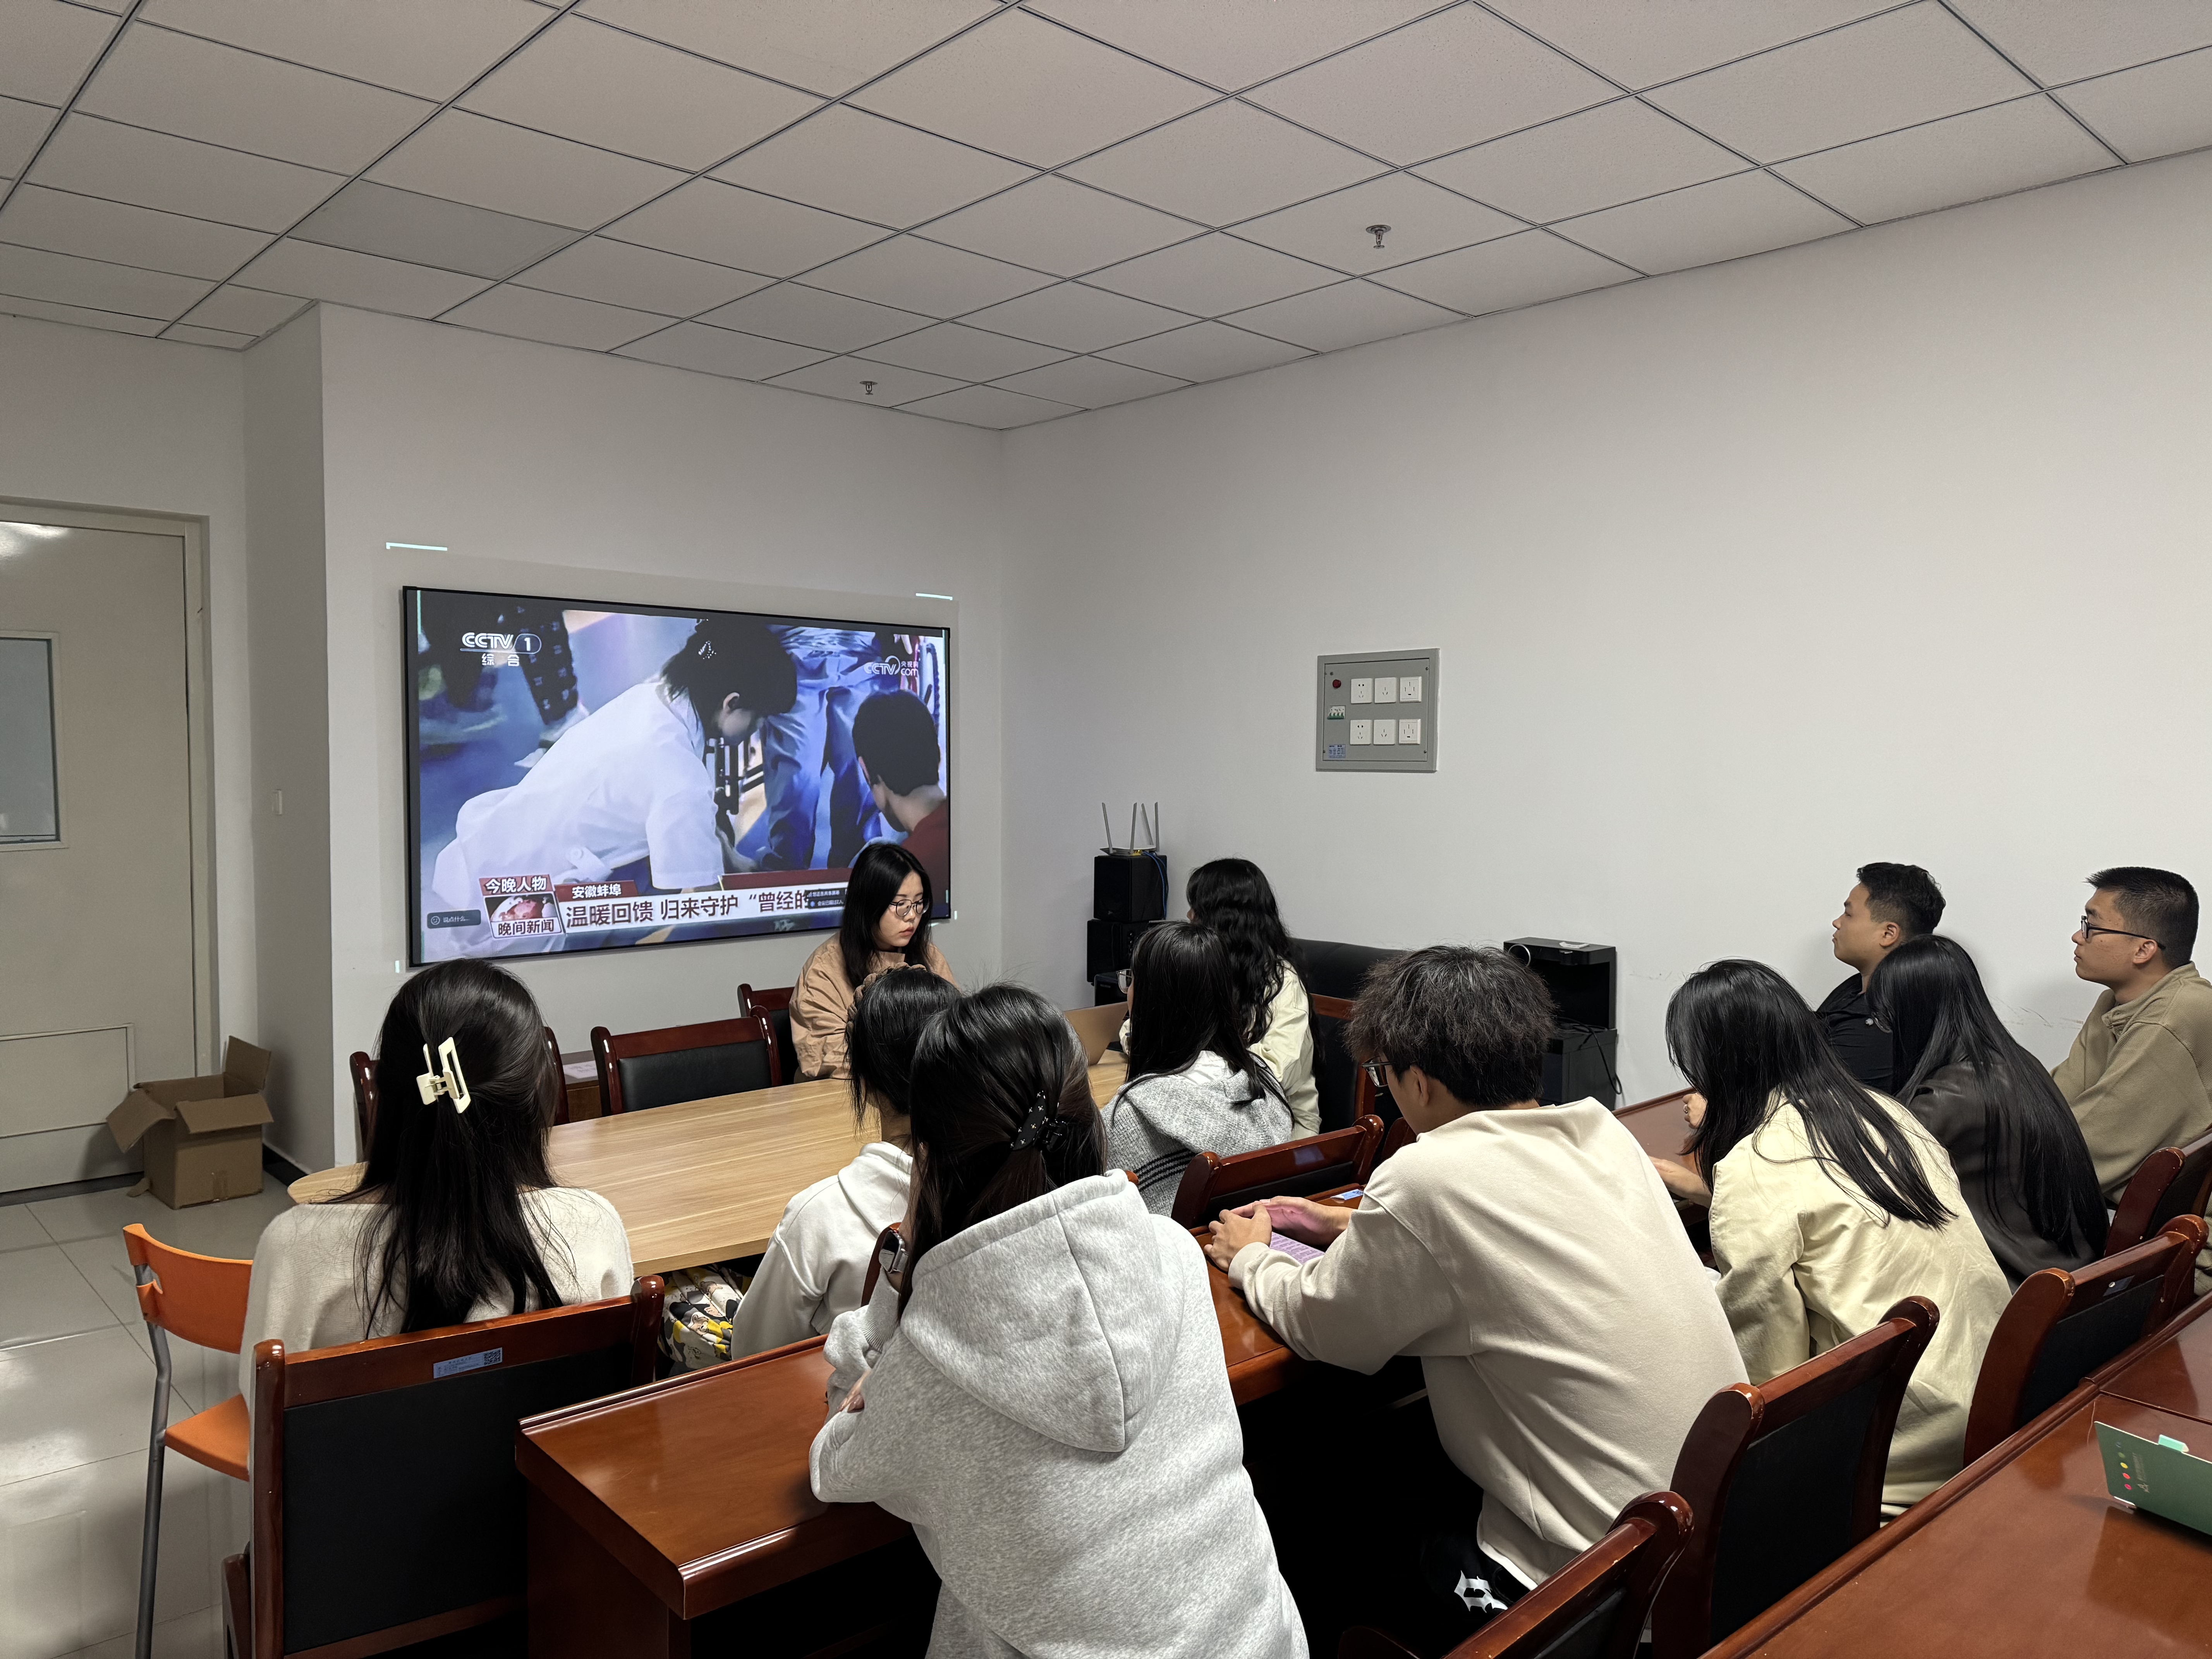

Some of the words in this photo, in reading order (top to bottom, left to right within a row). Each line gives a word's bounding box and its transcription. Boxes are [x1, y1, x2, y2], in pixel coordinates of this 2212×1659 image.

[462, 632, 514, 649] CCTV
[524, 637, 531, 651] 1
[481, 653, 520, 666] 综合
[864, 663, 896, 675] CCTV
[486, 876, 547, 894] 今晚人物
[572, 883, 622, 899] 安徽蚌埠
[566, 901, 654, 928] 温暖回馈
[661, 895, 738, 920] 归来守护
[498, 919, 554, 936] 晚间新闻
